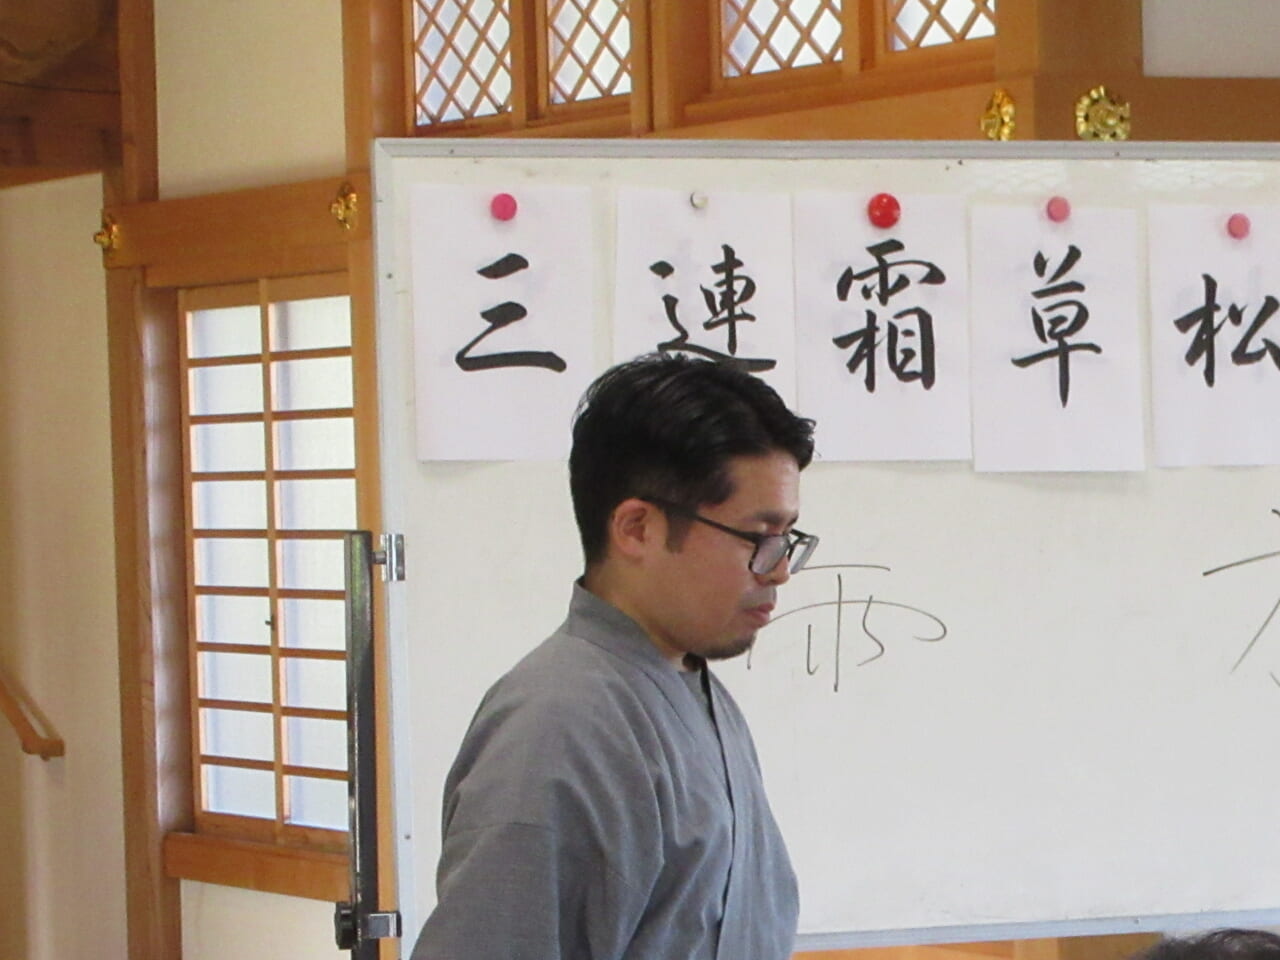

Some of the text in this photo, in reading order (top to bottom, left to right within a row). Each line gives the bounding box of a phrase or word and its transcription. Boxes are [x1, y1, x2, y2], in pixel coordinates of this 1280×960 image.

[455, 253, 567, 373] 三
[649, 243, 777, 373] 連
[832, 238, 946, 393] 霜
[1011, 245, 1101, 407] 草
